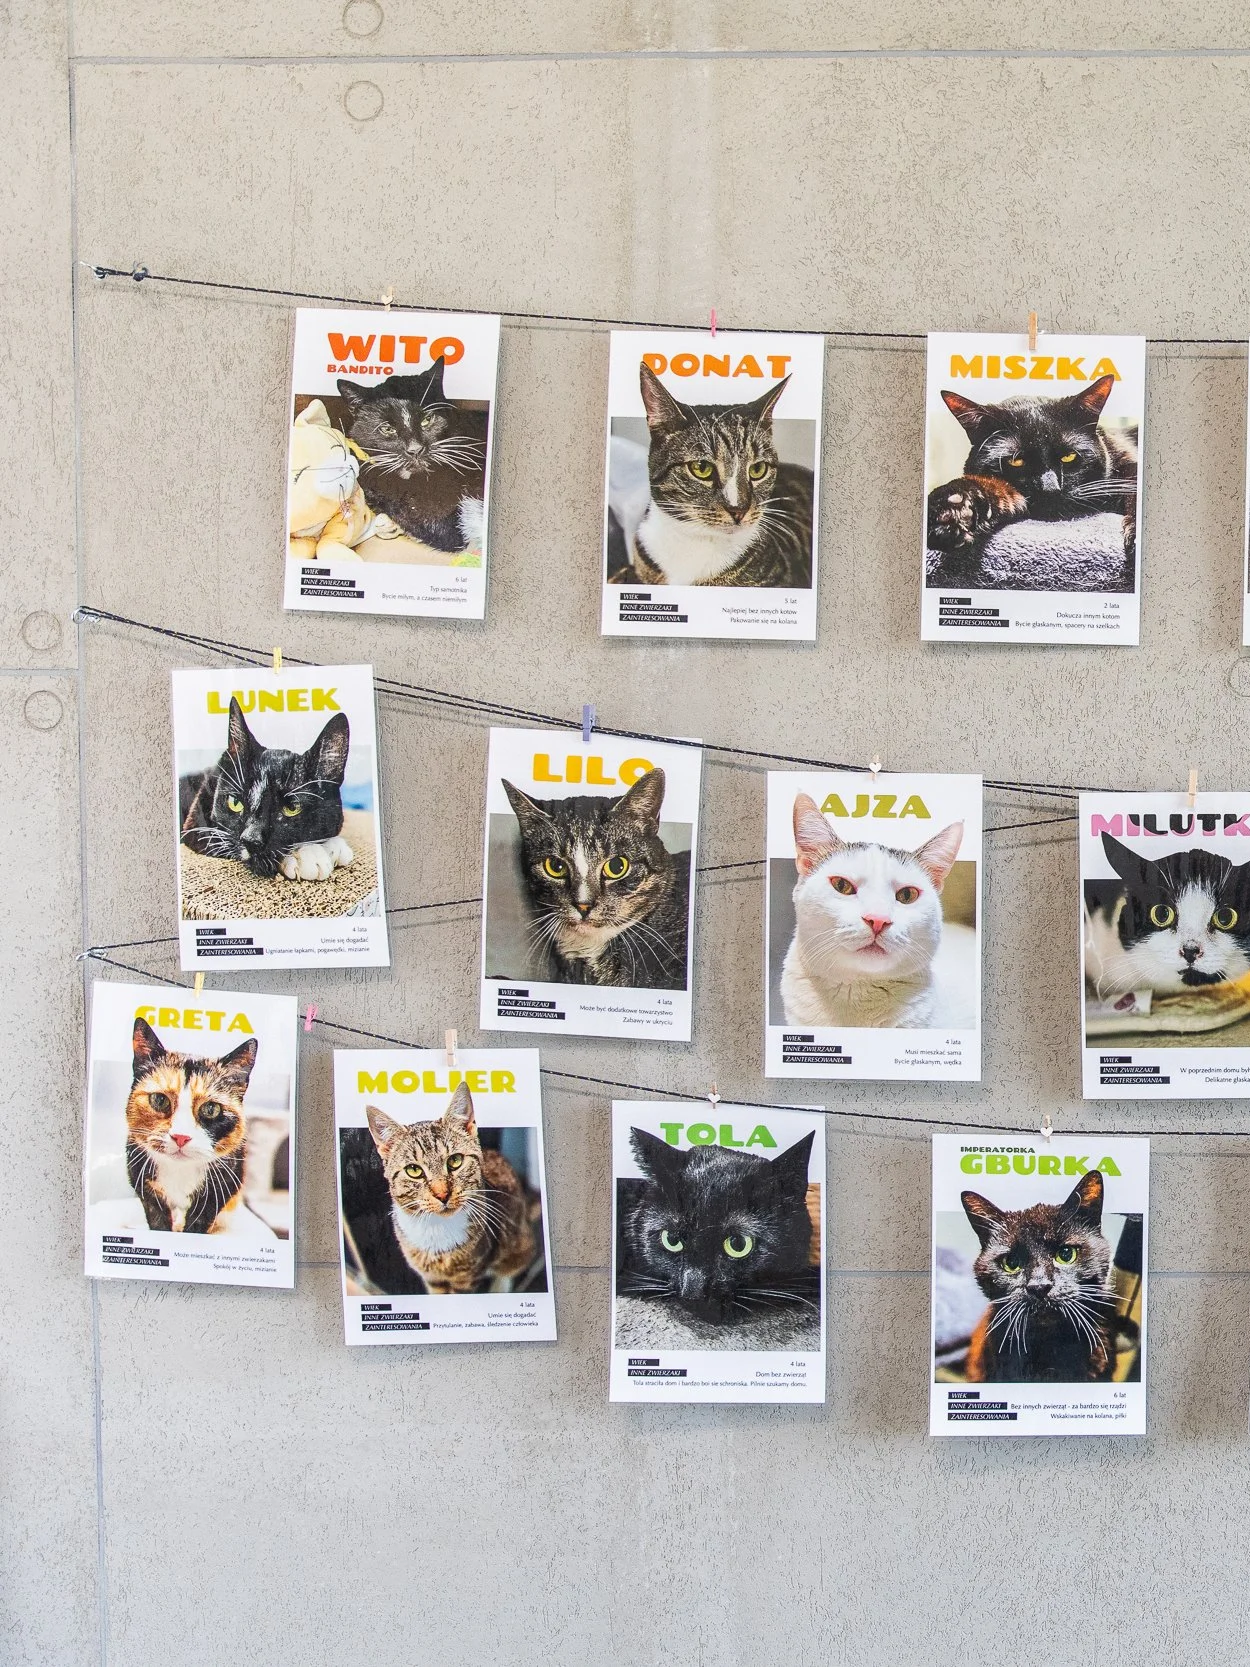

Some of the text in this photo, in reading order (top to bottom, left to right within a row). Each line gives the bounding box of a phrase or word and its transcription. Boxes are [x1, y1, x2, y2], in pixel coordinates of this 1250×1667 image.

[327, 333, 465, 366] WITO
[327, 364, 394, 376] BANDITO
[642, 353, 791, 378] DONAT
[949, 355, 1122, 382] MISZKA
[303, 589, 357, 597] ZAINTERESOWANIA
[206, 687, 341, 714] LUNEK
[532, 753, 655, 787] LILO
[821, 793, 932, 819] AJZA
[134, 1005, 255, 1034] GRETA
[357, 1070, 517, 1094] MOLIER
[659, 1122, 778, 1148] TOLA
[960, 1146, 1036, 1154] IMPERATORKA
[960, 1153, 1122, 1177] GBURKA
